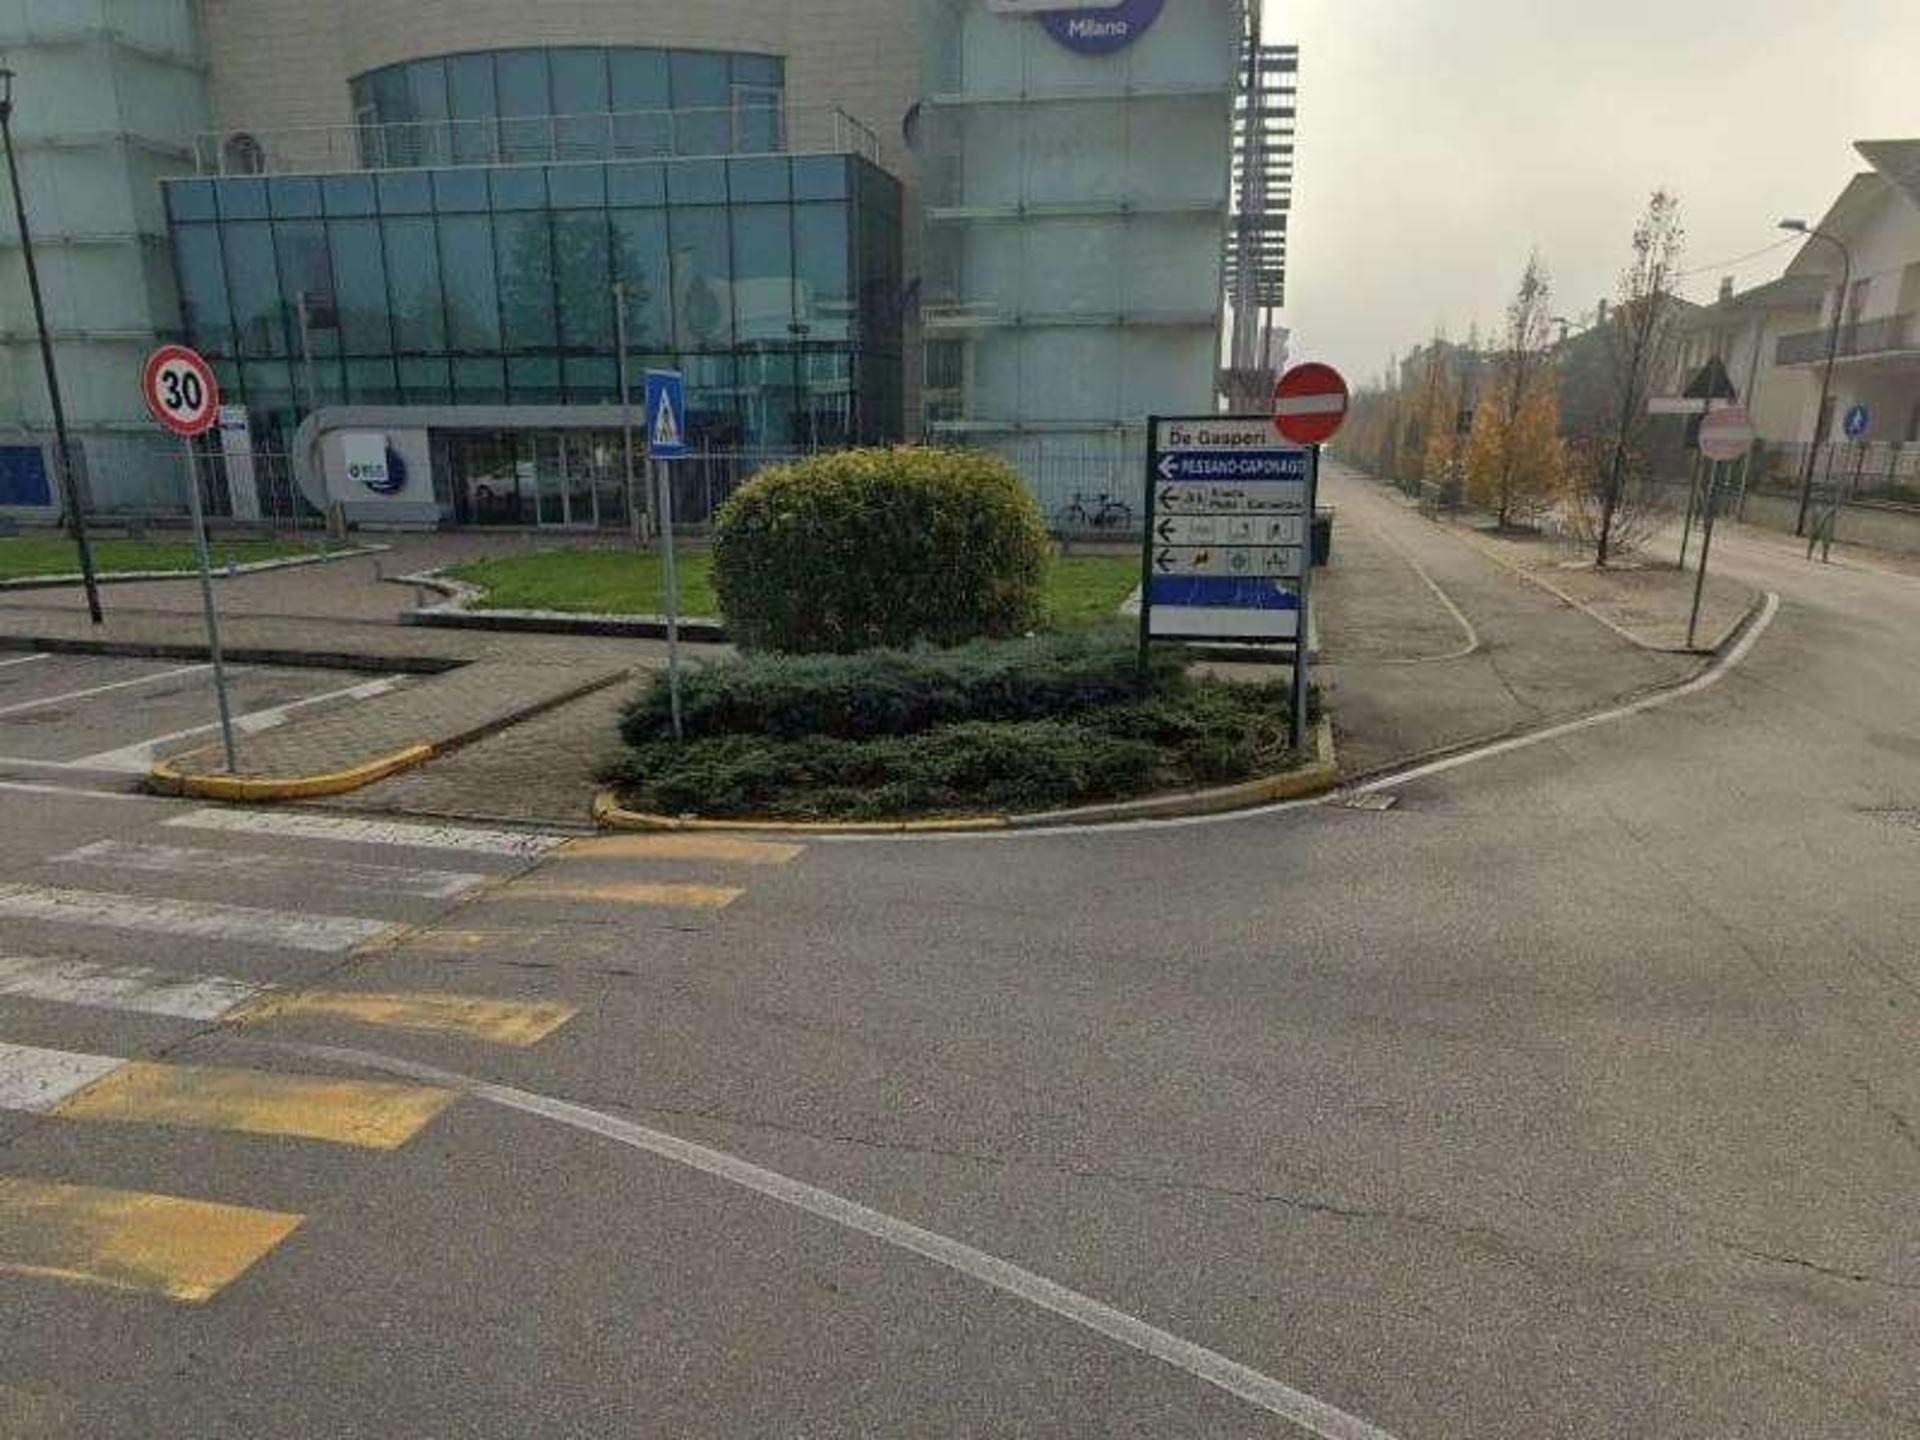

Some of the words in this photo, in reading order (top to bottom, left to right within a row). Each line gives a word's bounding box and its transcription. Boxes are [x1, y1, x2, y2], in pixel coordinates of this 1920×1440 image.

[1069, 17, 1128, 38] Milano
[162, 369, 202, 411] 30
[1170, 431, 1192, 445] De
[1198, 431, 1266, 449] Gasperi
